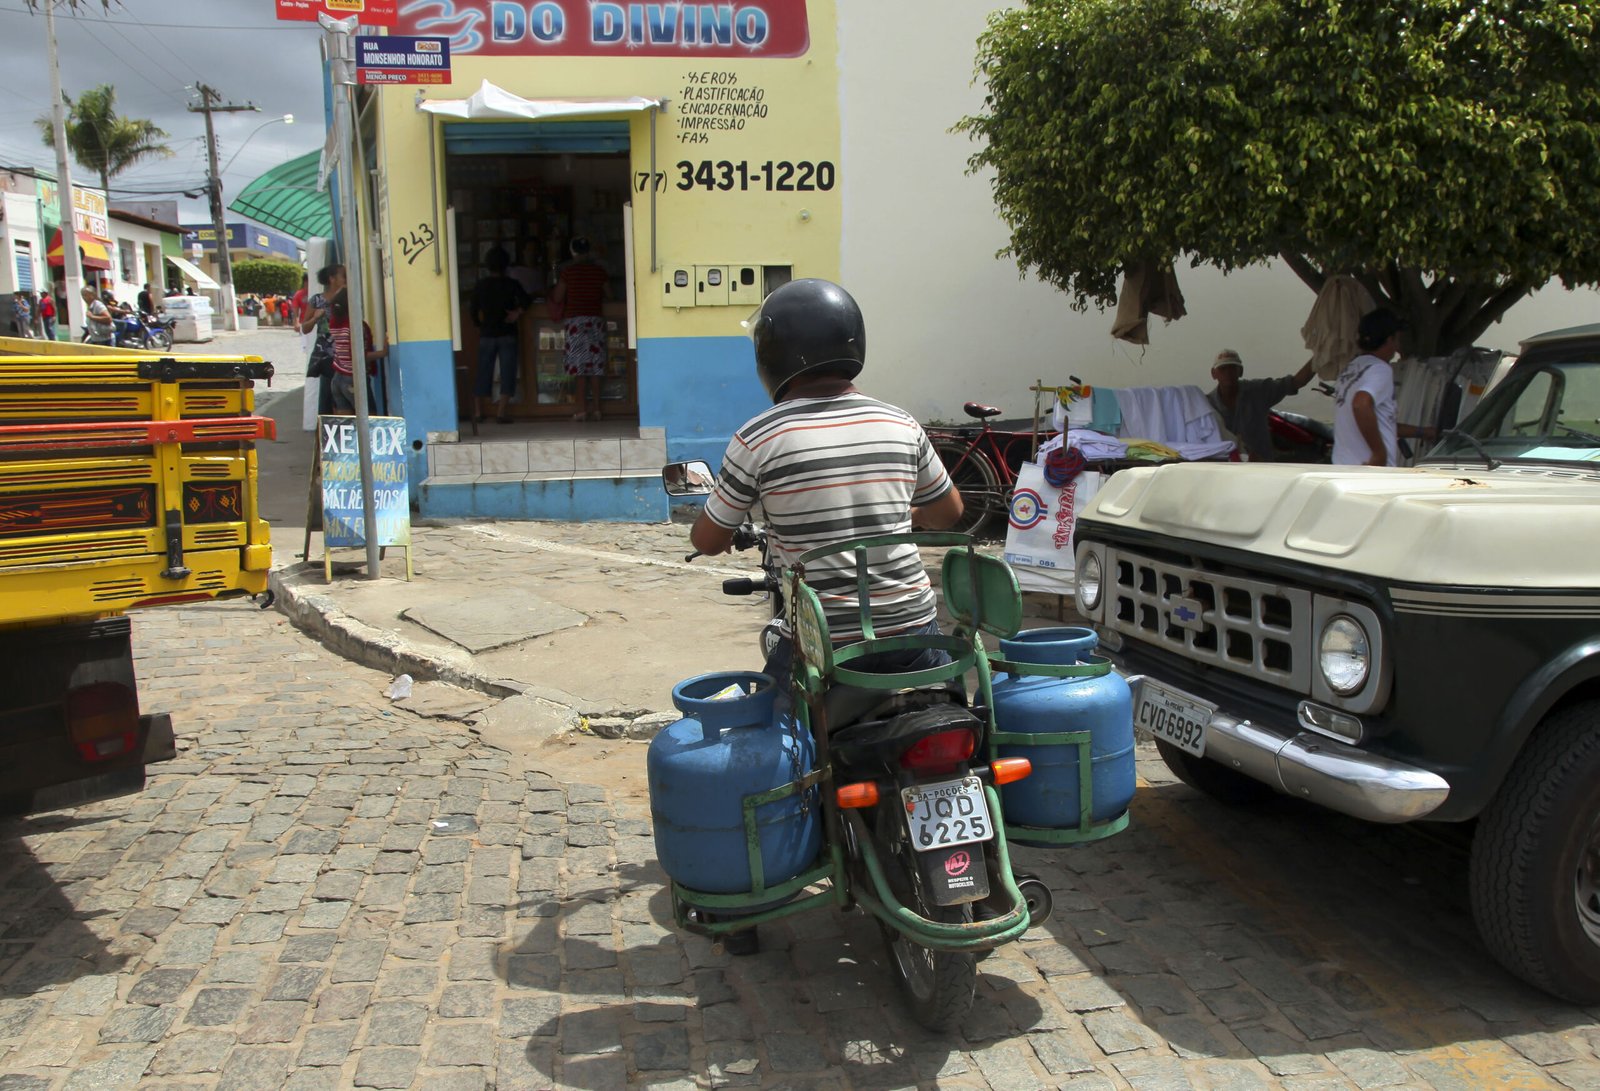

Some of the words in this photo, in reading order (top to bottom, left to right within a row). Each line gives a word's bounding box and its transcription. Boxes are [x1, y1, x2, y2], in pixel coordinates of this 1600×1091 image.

[492, 2, 565, 42] DO
[591, 2, 769, 46] DIVINO
[363, 42, 379, 51] RUA
[363, 53, 406, 65] MONSENHOR
[407, 54, 443, 66] HONORATO
[688, 72, 737, 85] XEROX
[683, 86, 765, 102] PLASTIFICAÇÃO
[680, 102, 768, 118] ENCADERNAÇÃO
[680, 116, 746, 131] IMPRESSÃO
[681, 132, 709, 144] FAX
[634, 170, 668, 193] (77)
[676, 160, 835, 191] 3431-1220
[397, 222, 434, 257] 243
[323, 424, 404, 455] XEOX
[919, 794, 974, 822] JQD
[918, 816, 986, 847] 6225
